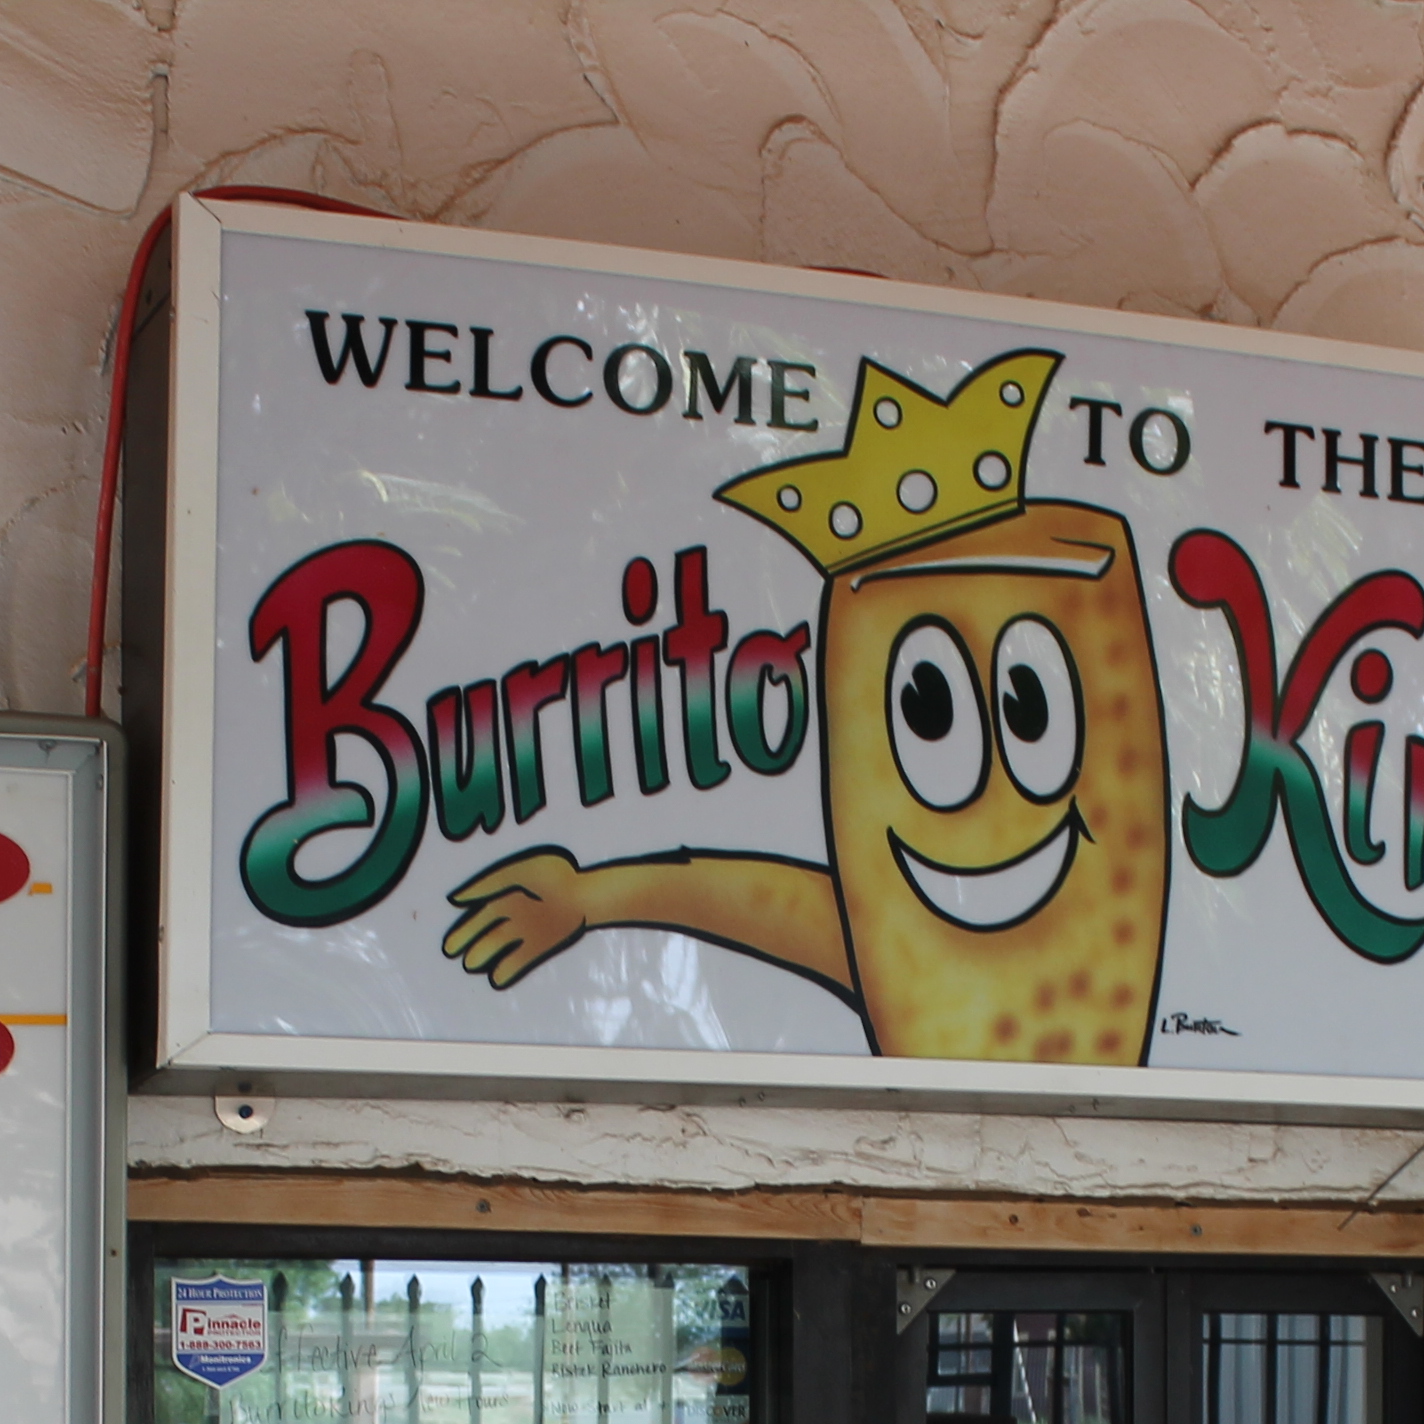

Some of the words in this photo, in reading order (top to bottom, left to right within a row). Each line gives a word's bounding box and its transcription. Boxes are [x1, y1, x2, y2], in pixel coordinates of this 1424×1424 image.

[304, 308, 821, 434] WELCOME
[1068, 397, 1194, 476] TO
[240, 537, 810, 927] Burrito
[180, 1307, 262, 1336] Pinnacle
